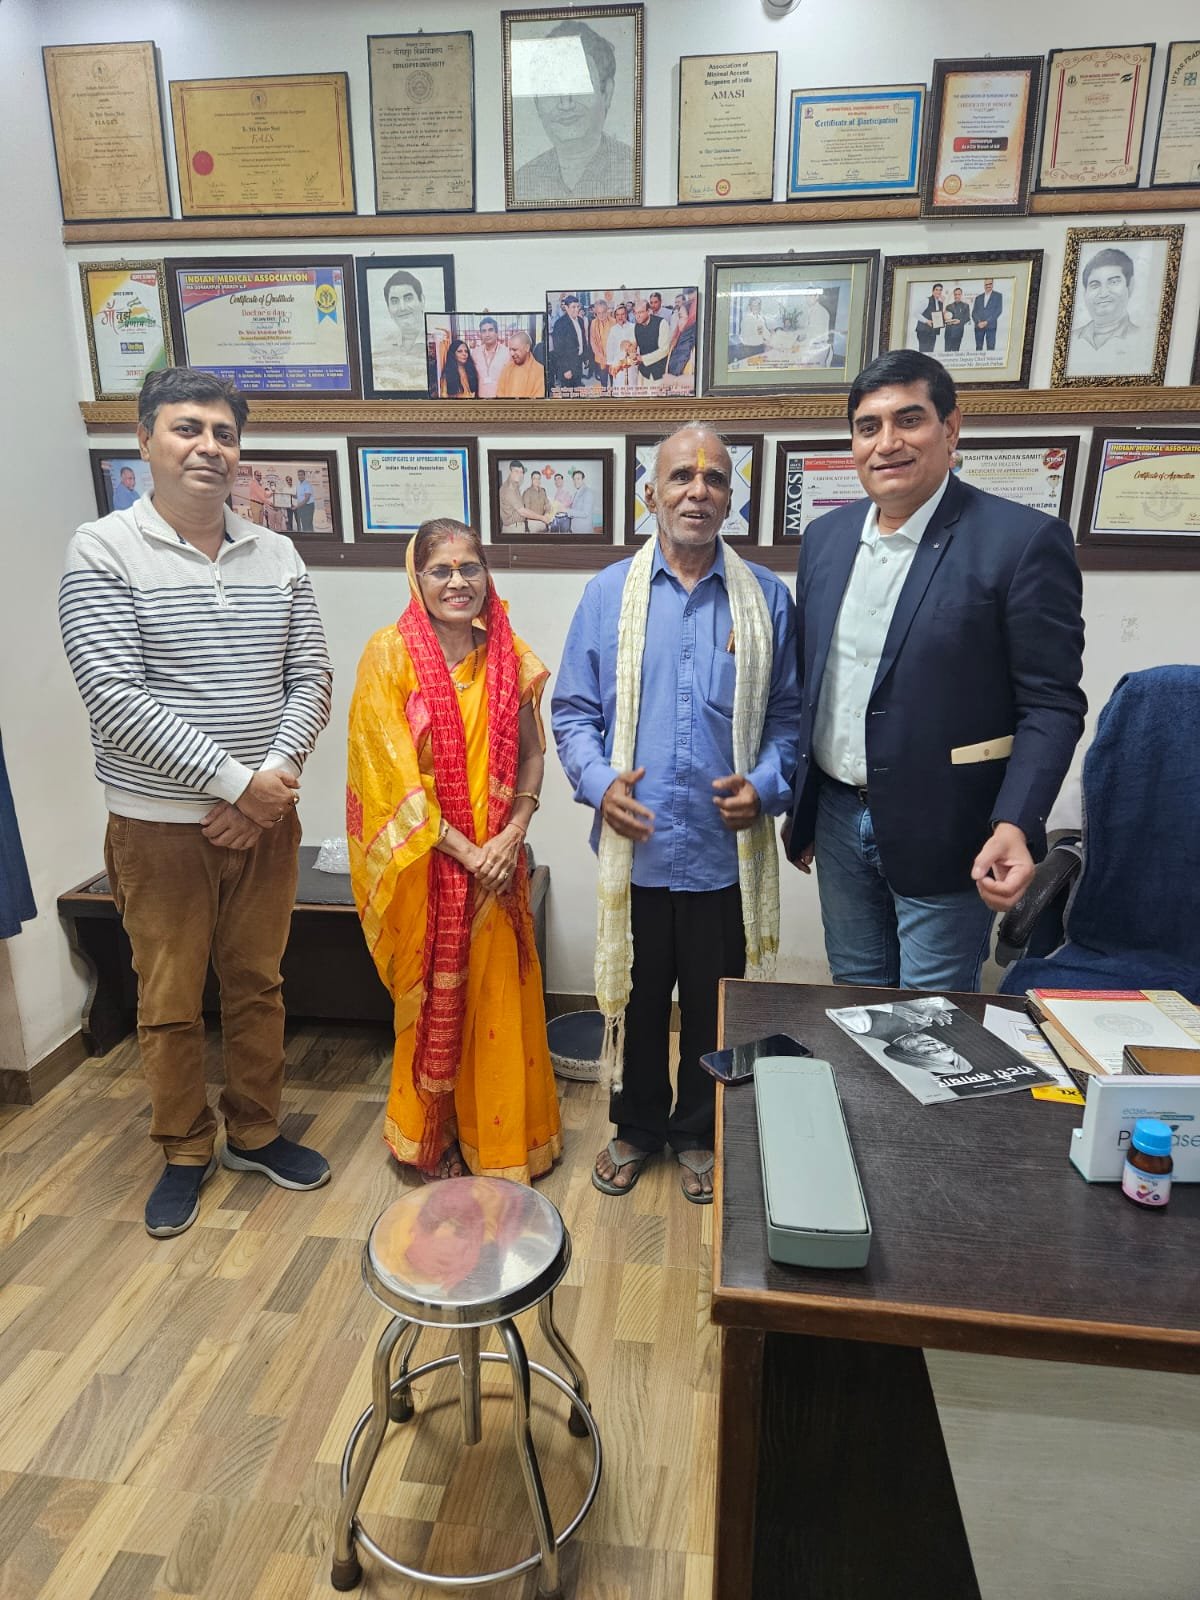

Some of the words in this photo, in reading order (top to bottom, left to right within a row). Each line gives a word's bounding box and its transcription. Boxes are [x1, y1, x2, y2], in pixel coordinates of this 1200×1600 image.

[1171, 62, 1184, 84] UTTAR
[712, 90, 745, 100] AMASI
[814, 119, 847, 128] Certificate
[857, 117, 898, 126] Participation
[185, 274, 215, 283] INDIAN
[218, 274, 252, 282] MEDICAL
[254, 273, 308, 282] ASSOCIATION
[229, 293, 258, 306] Certificate
[264, 293, 295, 306] Gratitude
[1134, 470, 1158, 480] Certificate
[786, 473, 803, 530] MACS
[937, 1072, 994, 1088] समाचार
[994, 1066, 1038, 1082] रोटरी
